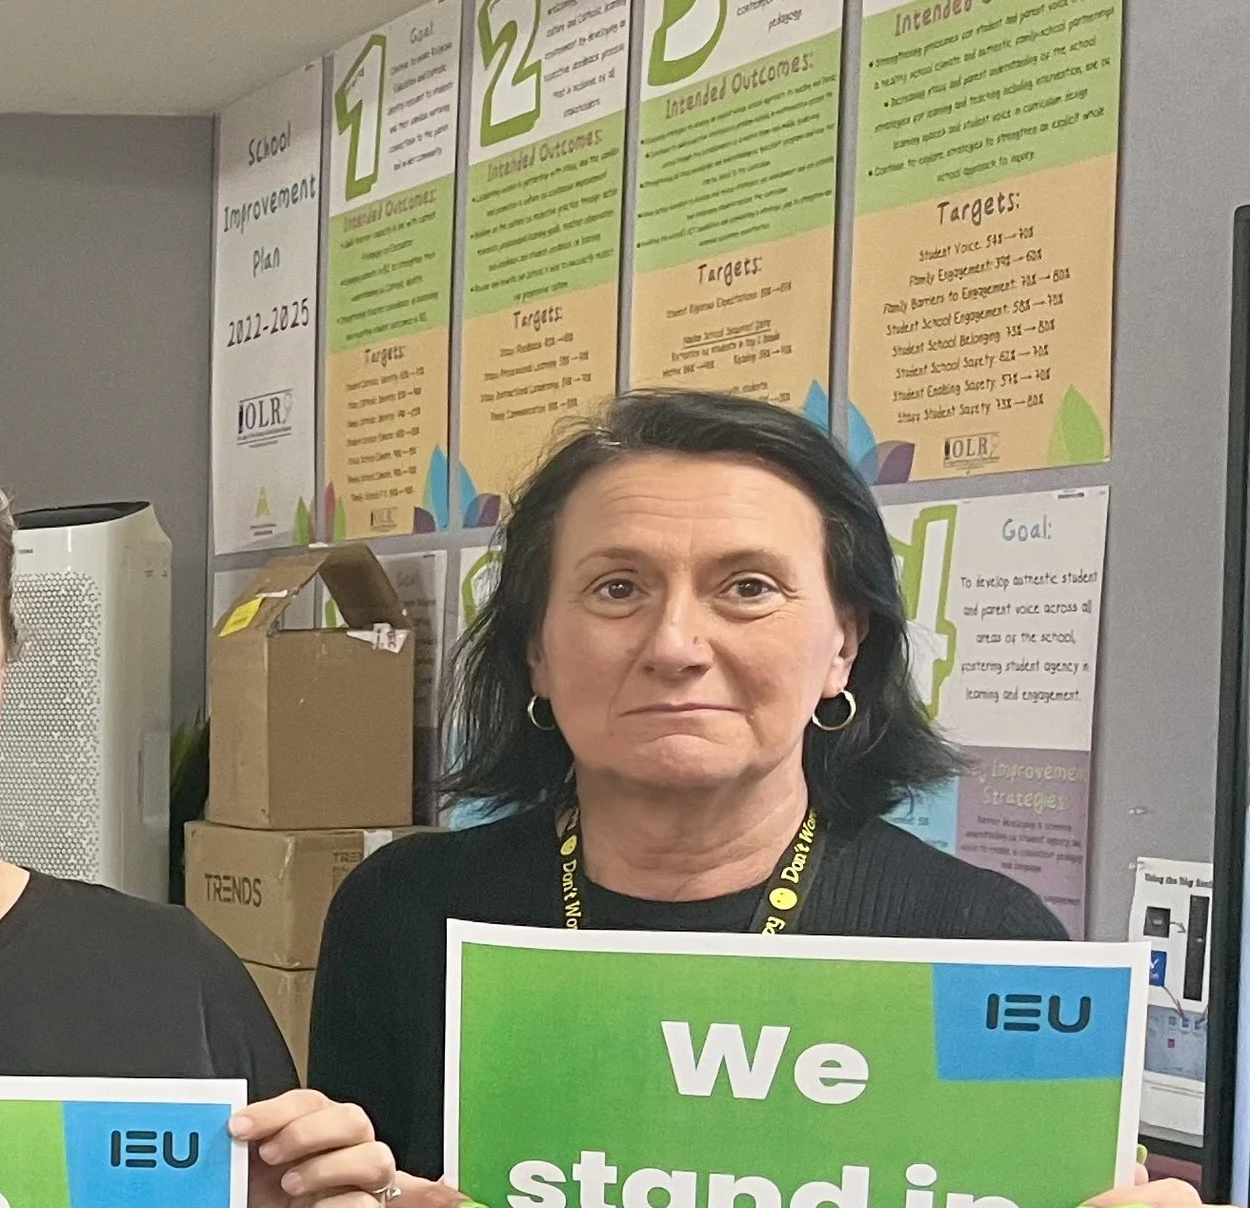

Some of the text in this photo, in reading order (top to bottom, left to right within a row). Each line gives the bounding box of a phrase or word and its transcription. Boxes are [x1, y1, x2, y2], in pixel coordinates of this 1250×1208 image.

[666, 79, 727, 119] Intended
[335, 34, 387, 202] 1
[248, 120, 291, 166] School
[223, 174, 317, 234] Improvement
[937, 192, 1020, 226] Targets:
[253, 246, 280, 278] Plan
[227, 298, 309, 348] 2022-2025
[886, 321, 919, 336] Student
[922, 313, 951, 331] School
[1002, 514, 1051, 541] Goal:
[960, 576, 971, 588] To
[976, 574, 1009, 591] develop
[1062, 568, 1098, 584] student
[963, 600, 1092, 620] and parent voice across all
[976, 633, 1001, 643] areas
[1021, 632, 1036, 643] the
[1005, 660, 1039, 672] student
[1044, 661, 1078, 675] agency
[966, 686, 999, 702] learning
[1003, 686, 1018, 700] and
[563, 859, 579, 901] Don't
[781, 843, 810, 883] Don't
[204, 873, 262, 908] TRENDS
[985, 993, 1092, 1034] IEU
[660, 1019, 870, 1105] We
[110, 1130, 200, 1169] IEU
